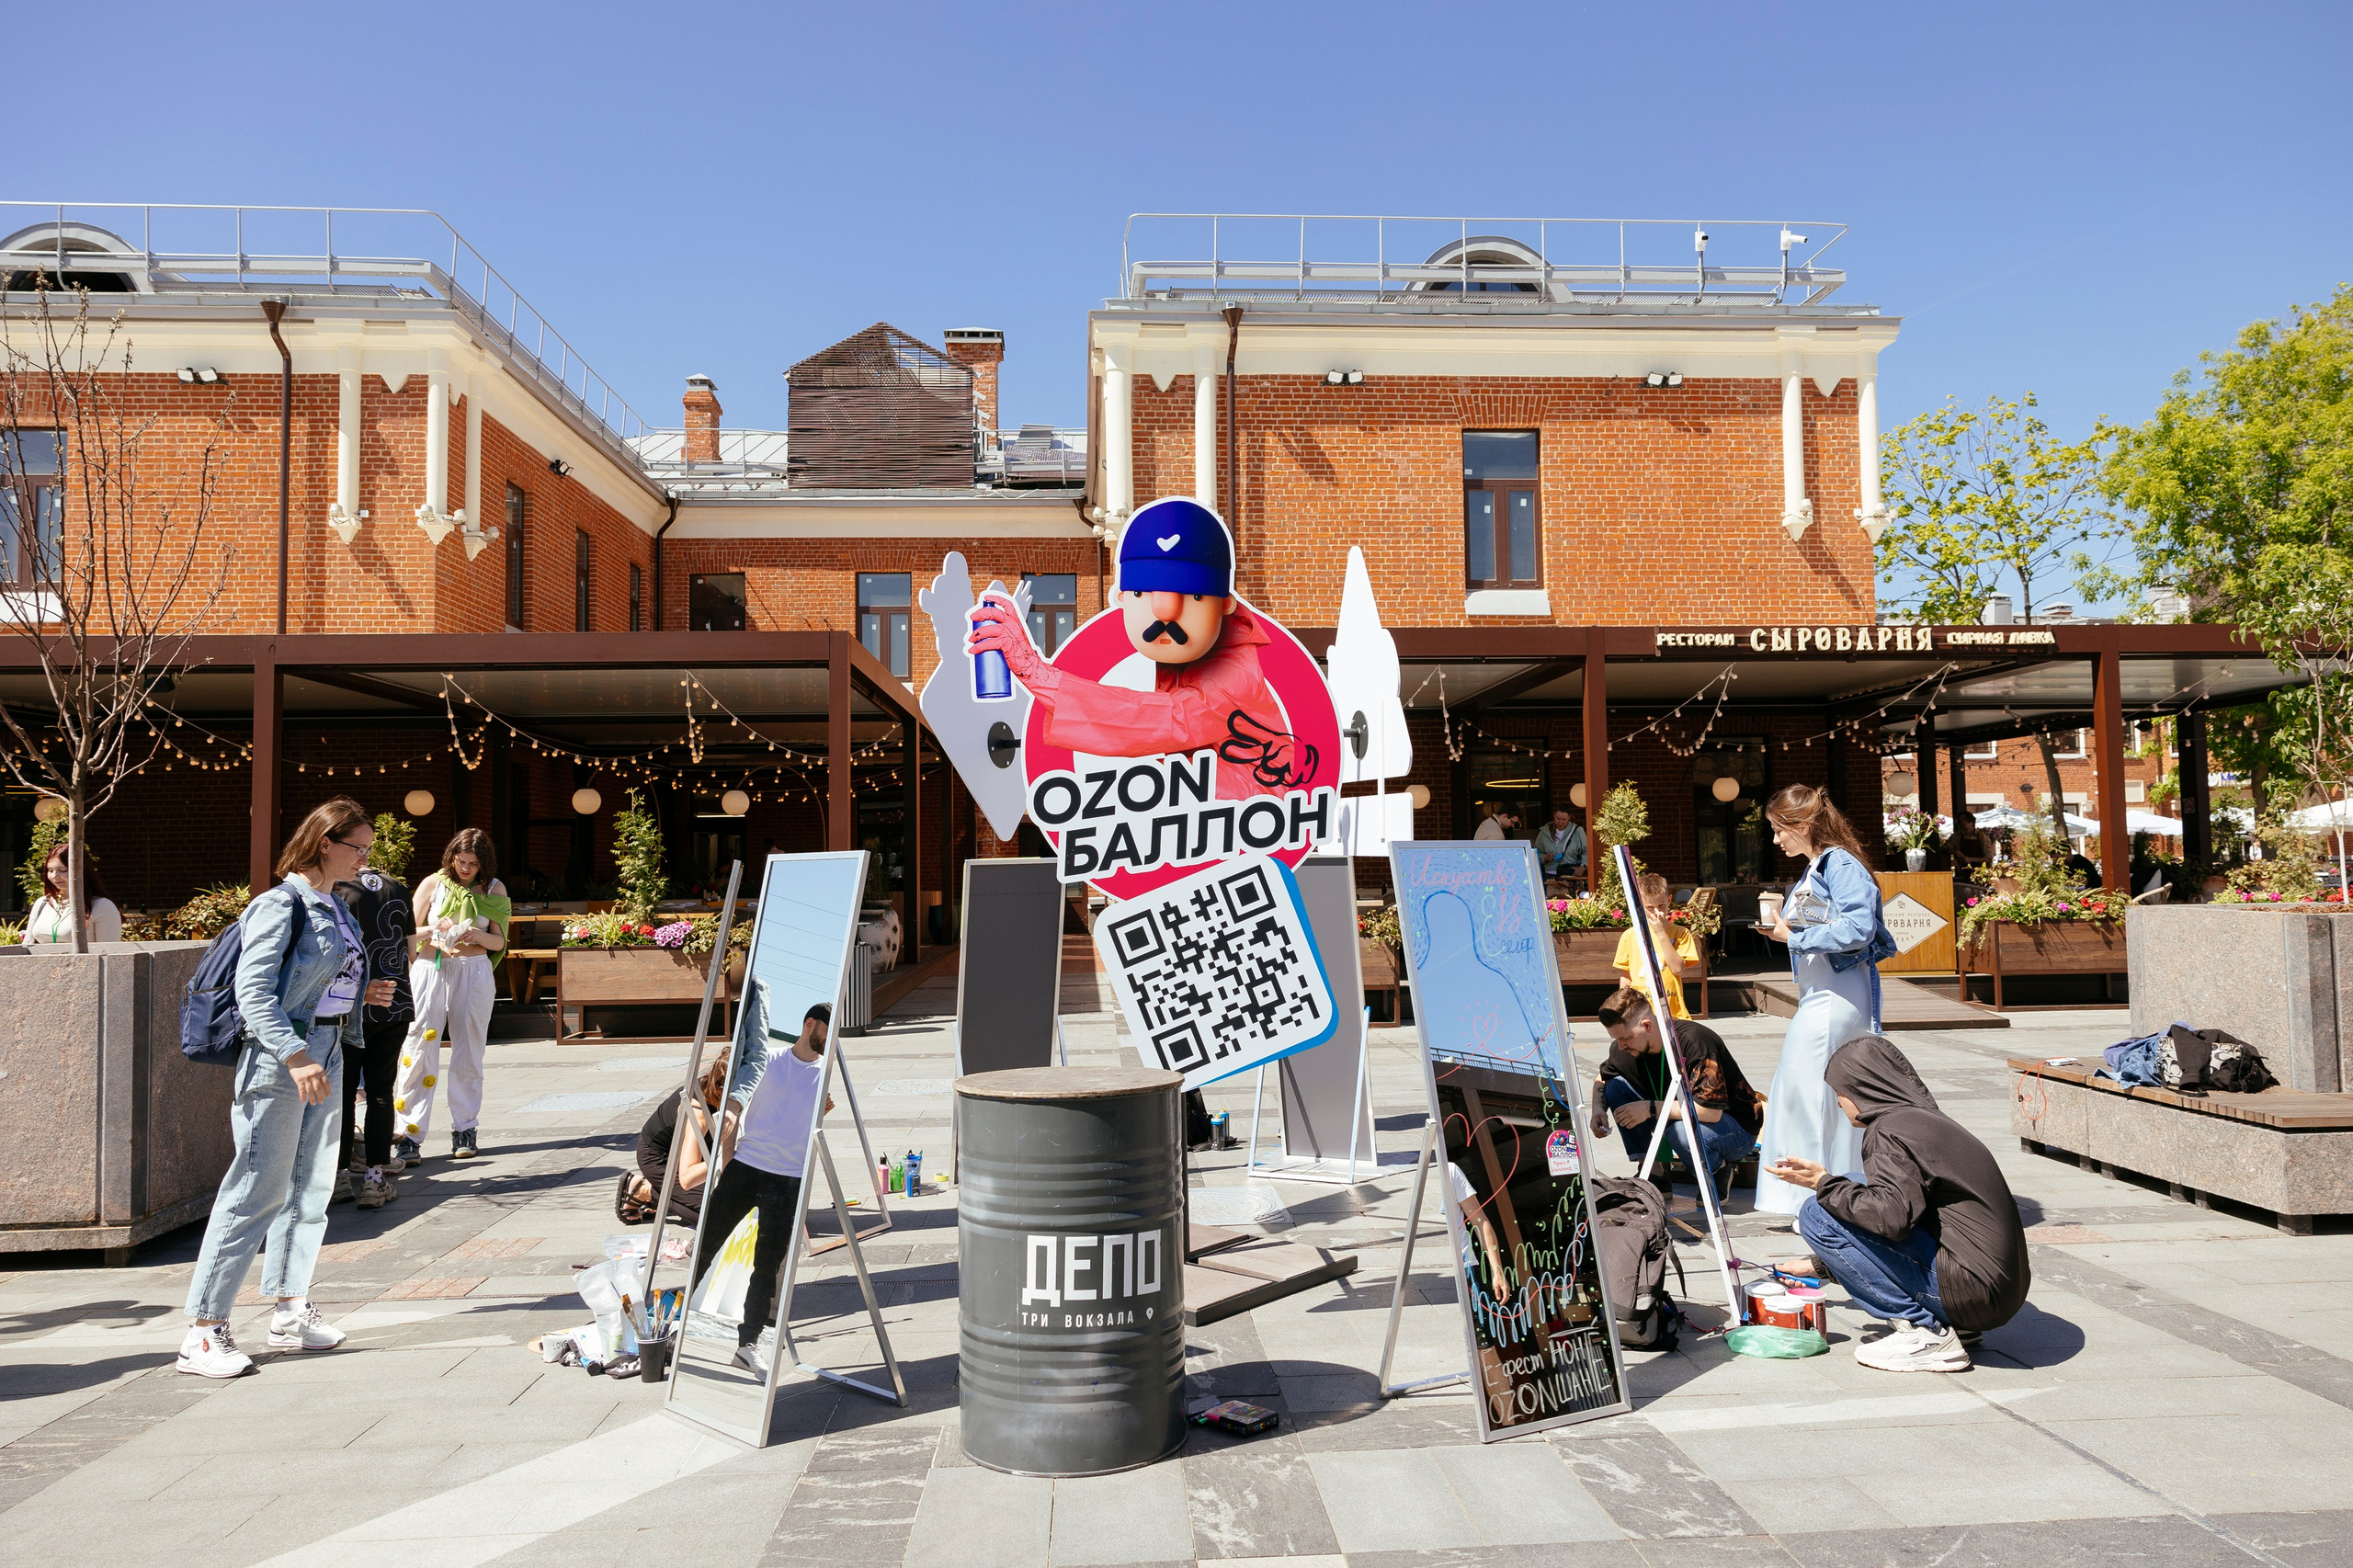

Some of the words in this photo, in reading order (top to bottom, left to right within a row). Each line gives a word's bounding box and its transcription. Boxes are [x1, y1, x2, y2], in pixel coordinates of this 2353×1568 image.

[1656, 631, 1735, 647] РЕСТОРАН
[1749, 626, 1933, 653] СЫРОВАРНЯ
[1946, 631, 2005, 645] СЫРНАЯ
[2007, 631, 2056, 645] ЛАВКА
[1033, 756, 1211, 825] OZON
[1063, 793, 1329, 877] БАЛЛОН
[1883, 918, 1931, 928] РОВАРНЯ
[1022, 1229, 1162, 1308] ДЕПО
[1022, 1312, 1049, 1327] ТРИ
[1065, 1310, 1134, 1328] ВОКЗАЛА
